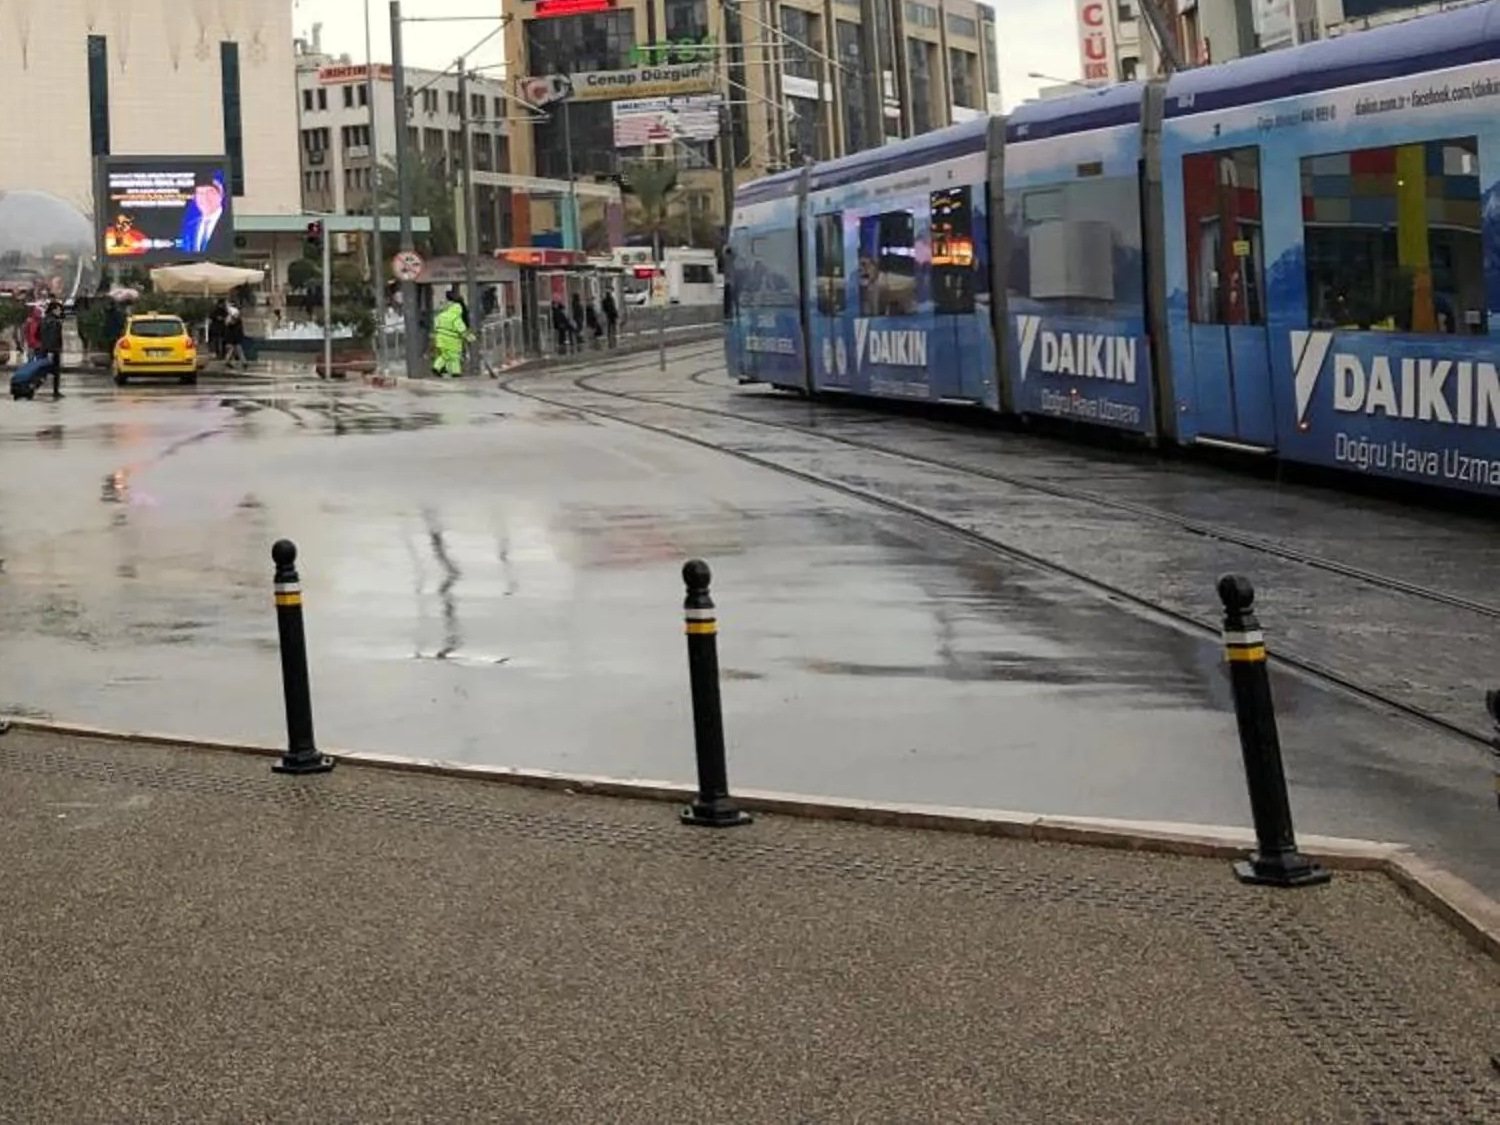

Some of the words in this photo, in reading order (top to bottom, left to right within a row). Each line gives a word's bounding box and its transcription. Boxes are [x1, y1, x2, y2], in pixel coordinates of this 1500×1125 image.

[868, 329, 928, 367] DAIKIN
[1041, 331, 1137, 383] DAIKIN
[1334, 353, 1500, 429] DAIKIN
[1335, 432, 1387, 470] Doğru
[1391, 440, 1439, 476] Hava
